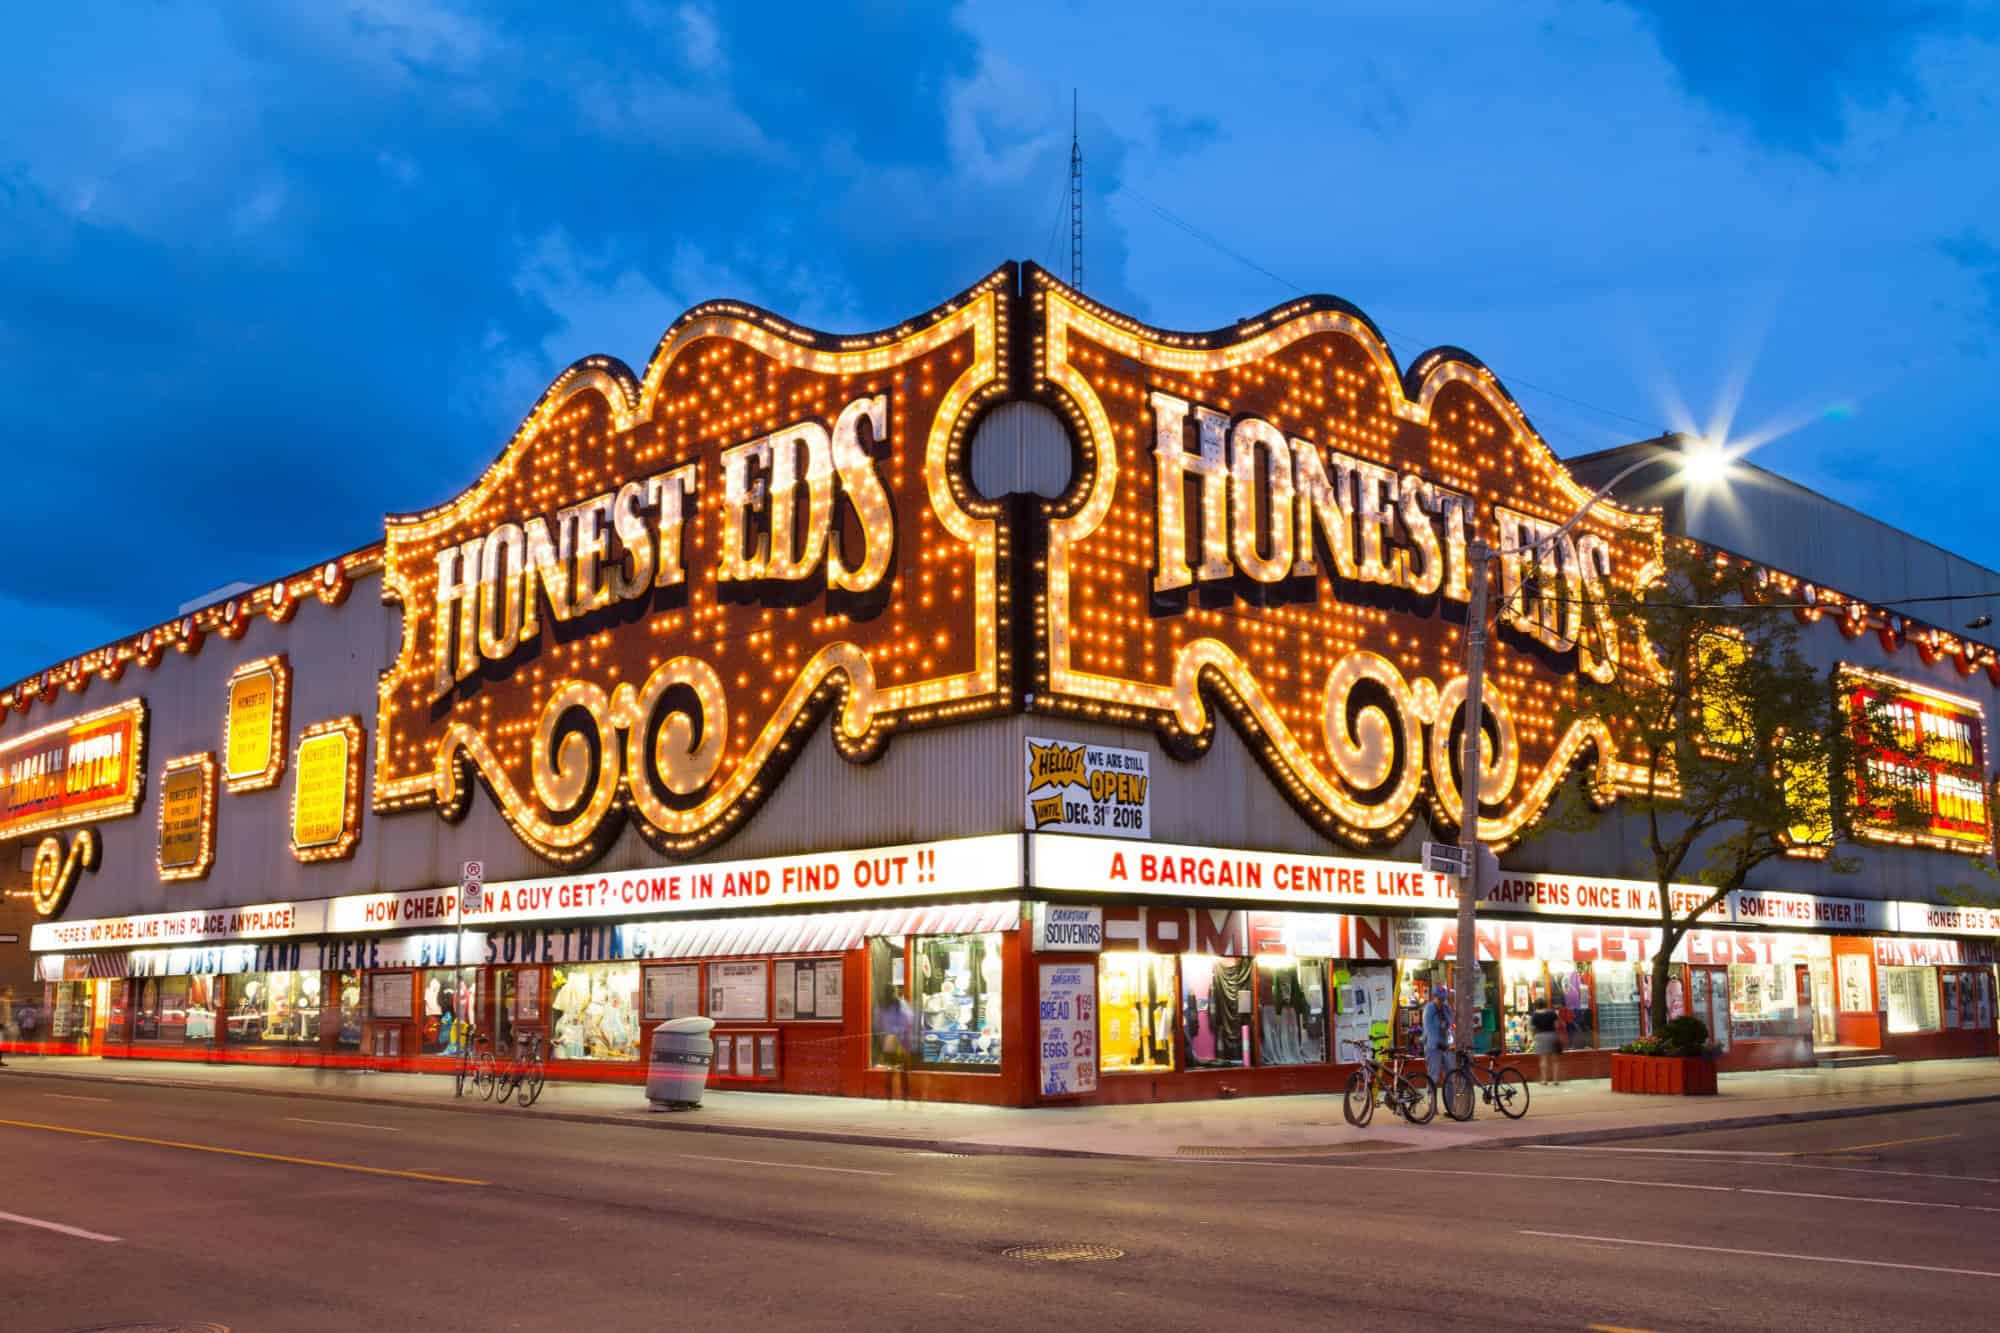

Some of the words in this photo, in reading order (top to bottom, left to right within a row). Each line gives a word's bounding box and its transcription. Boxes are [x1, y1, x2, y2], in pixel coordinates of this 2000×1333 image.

[1150, 391, 1474, 604] HONEST
[433, 464, 698, 696] HONEST
[1039, 752, 1080, 776] HELLO!
[1087, 752, 1104, 766] WE
[1106, 753, 1122, 769] ARE
[1124, 756, 1144, 771] STILL
[1090, 769, 1148, 806] OPEN!
[1065, 802, 1091, 825] DEC.
[1113, 807, 1142, 829] 2016
[365, 900, 399, 922] HOW
[403, 895, 456, 921] CHEAP
[500, 890, 512, 911] A
[516, 885, 553, 910] GUY
[621, 875, 681, 904] COME
[691, 873, 713, 899] IN
[722, 869, 771, 897] AND
[783, 863, 840, 894] FIND
[854, 856, 908, 889] OUT
[1109, 852, 1128, 881] A
[1140, 853, 1262, 889] BARGAIN
[1273, 864, 1366, 895] CENTRE
[1377, 872, 1425, 897] LIKE
[1577, 885, 1620, 912] ONCE
[1627, 888, 1641, 909] IN
[1740, 896, 1811, 920] SOMETIMES
[1815, 901, 1852, 922] NEVER
[1927, 911, 1962, 928] HONEST
[90, 926, 102, 941] NO
[105, 922, 134, 940] PLACE
[137, 920, 159, 938] LIKE
[163, 919, 185, 936] THIS
[190, 914, 226, 938] PLACE,
[229, 907, 296, 932] ANYPLACE!
[1046, 923, 1101, 944] SOUVENIRS
[1340, 913, 1388, 959] IN
[1572, 927, 1651, 961] GET
[185, 949, 225, 975] JUST
[239, 943, 300, 973] STAND
[1040, 1001, 1069, 1020] BREAD
[1043, 1042, 1068, 1058] EGGS
